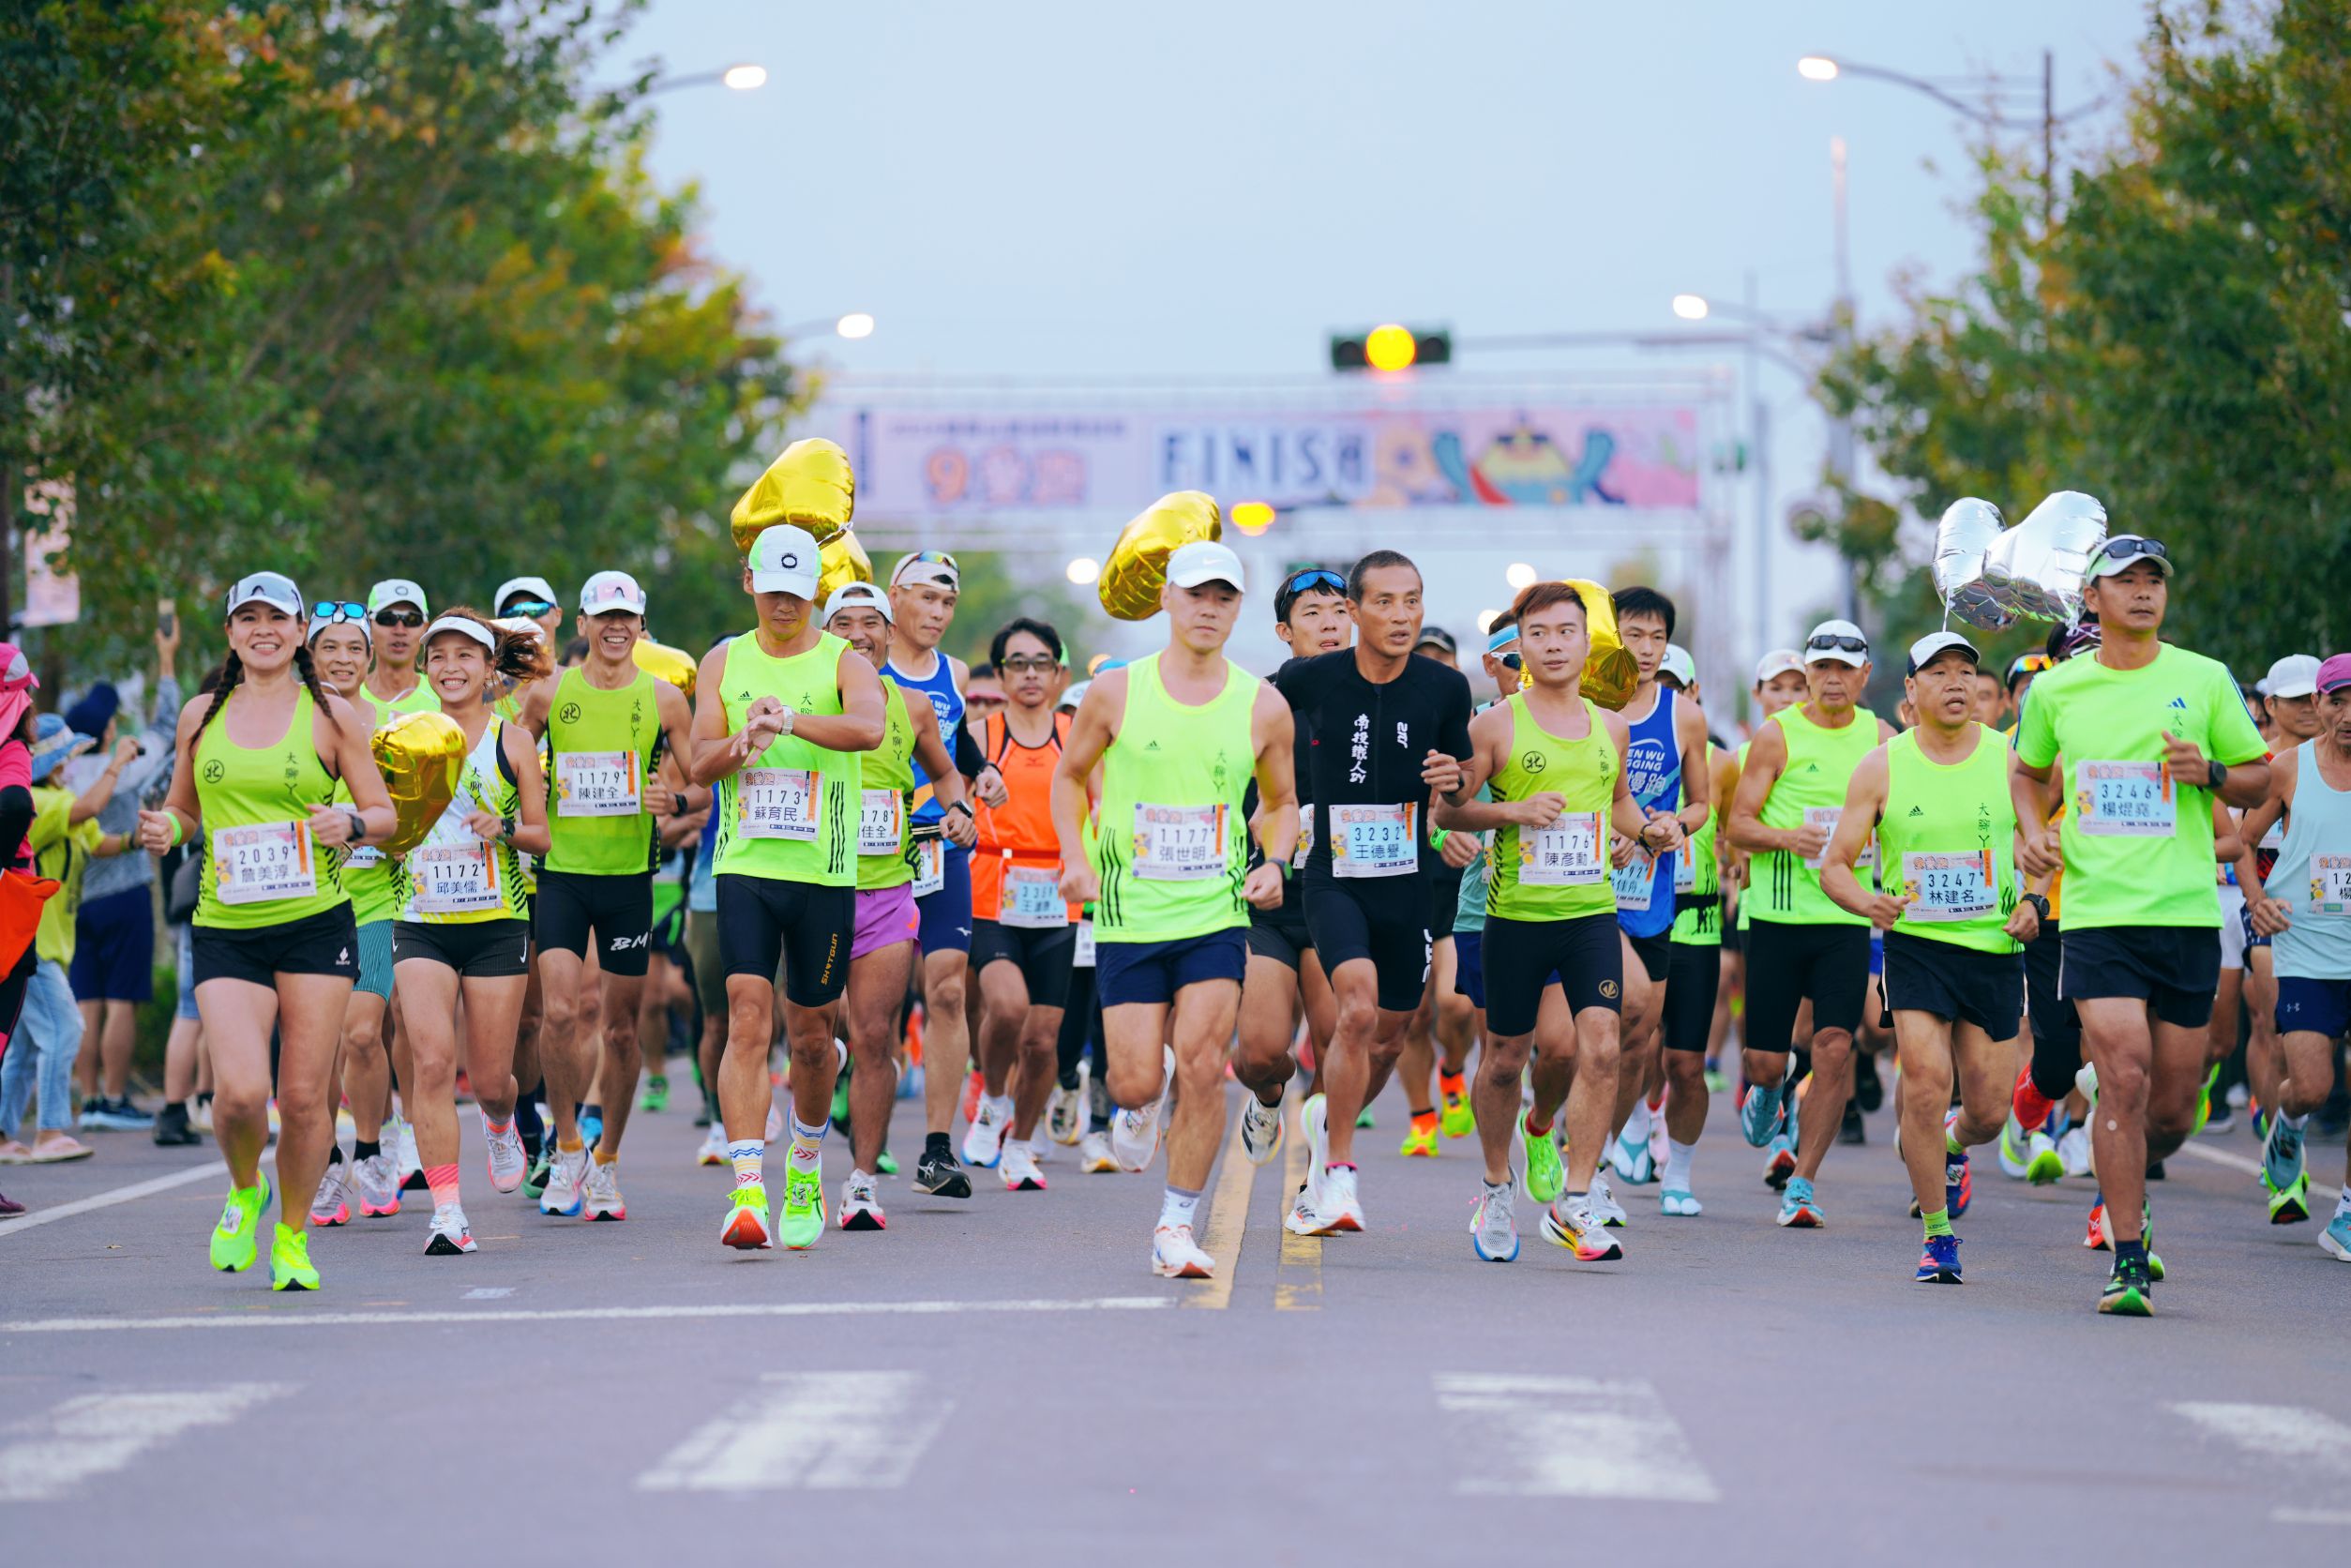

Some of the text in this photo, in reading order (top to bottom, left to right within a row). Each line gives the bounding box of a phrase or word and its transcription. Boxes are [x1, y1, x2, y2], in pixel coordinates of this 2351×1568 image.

[1526, 755, 1543, 770] 北
[1645, 750, 1665, 761] WU
[206, 761, 221, 779] 北
[578, 772, 620, 785] 1179
[579, 786, 619, 801] 陳建全
[756, 789, 800, 805] 1173
[2102, 783, 2152, 799] 3246
[754, 807, 797, 822] 蘇育民
[861, 809, 888, 822] 178
[857, 825, 886, 838] 佳全
[1161, 828, 1208, 843] 1177
[1354, 827, 1400, 841] 3232
[1545, 835, 1589, 850] 1176
[239, 846, 289, 865] 2039
[1159, 846, 1206, 862] 張世明
[433, 864, 479, 879] 1172
[1928, 872, 1975, 887] 3247
[1929, 889, 1975, 904] 林建名
